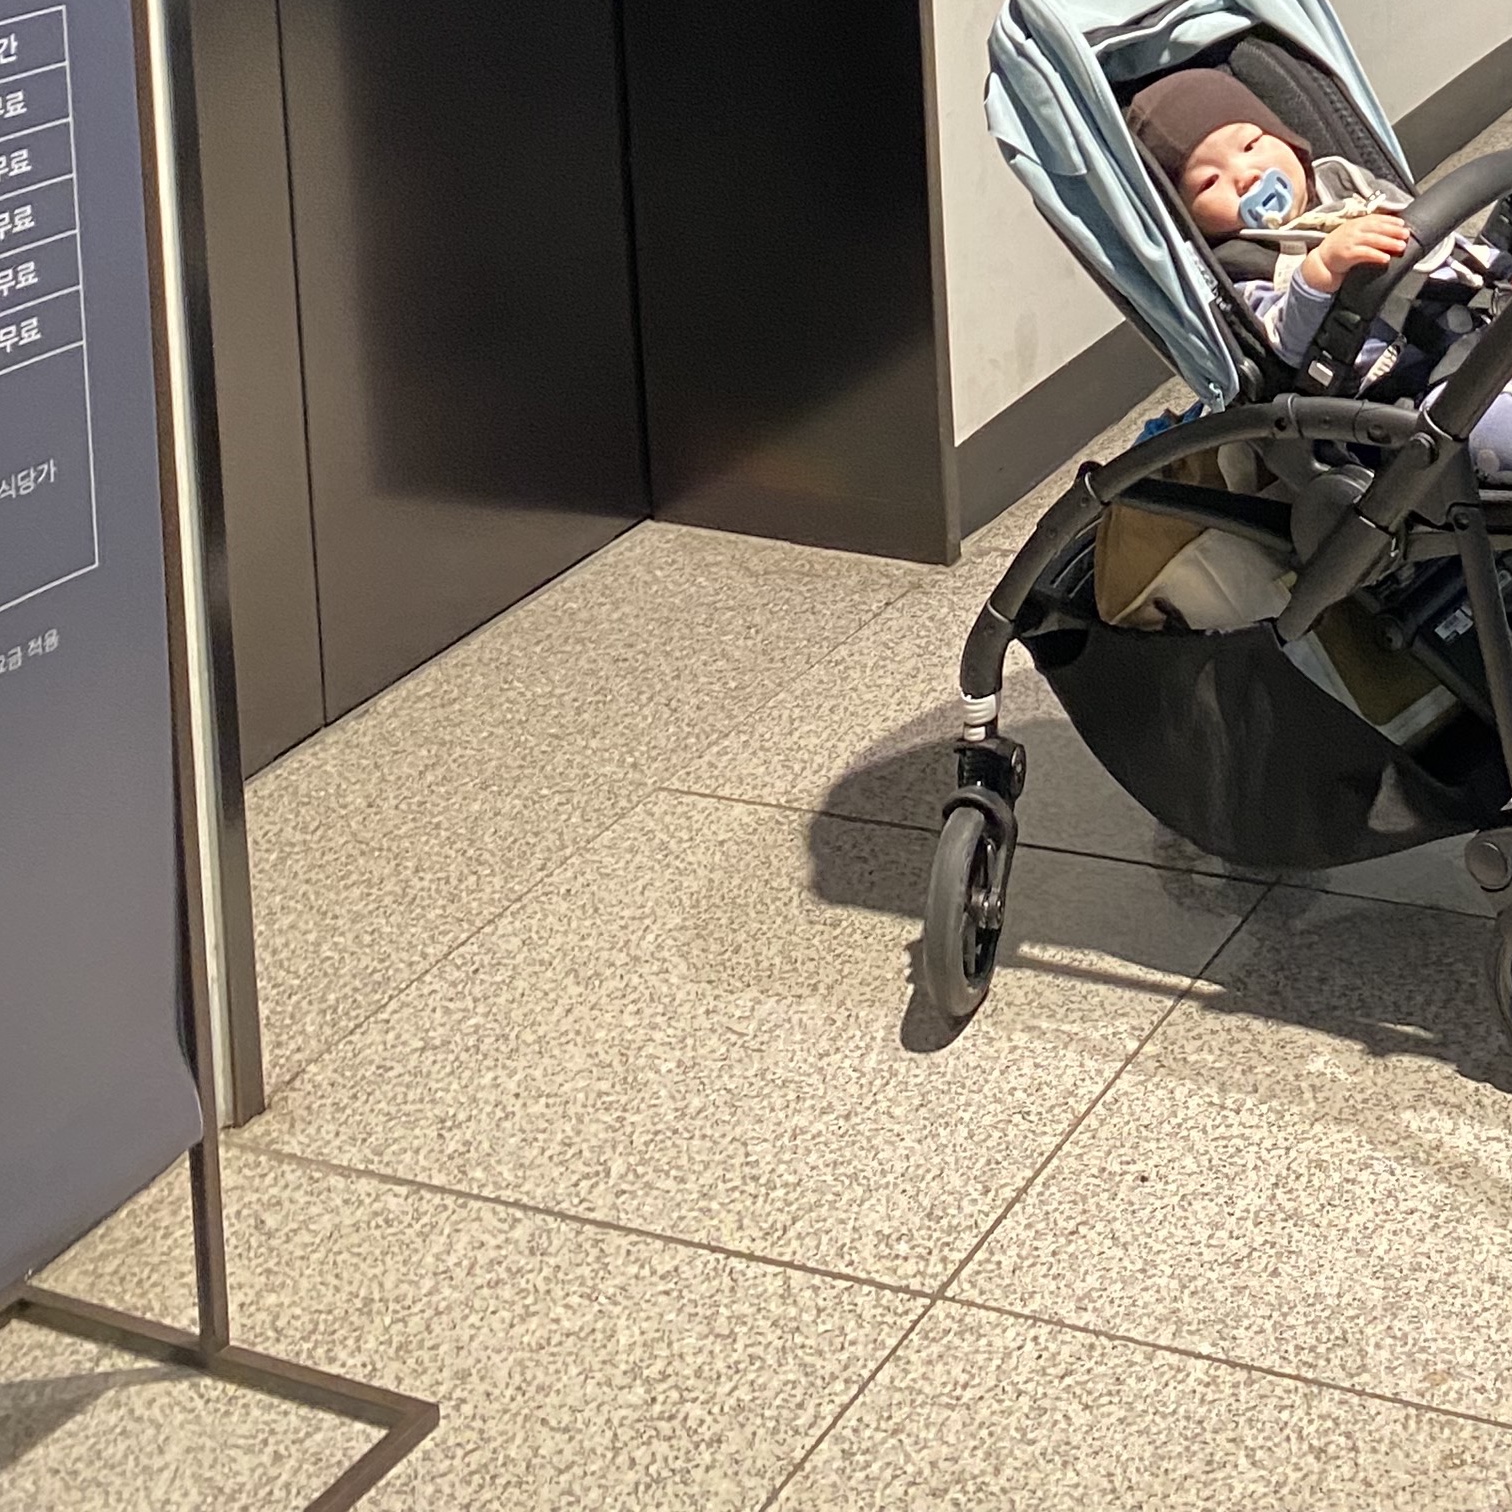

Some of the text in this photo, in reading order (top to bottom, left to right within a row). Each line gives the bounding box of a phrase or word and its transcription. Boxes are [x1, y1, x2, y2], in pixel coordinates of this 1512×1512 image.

[0, 90, 28, 119] 료
[0, 261, 39, 297] 무료
[0, 317, 42, 353] 무료
[27, 628, 60, 658] 적용
